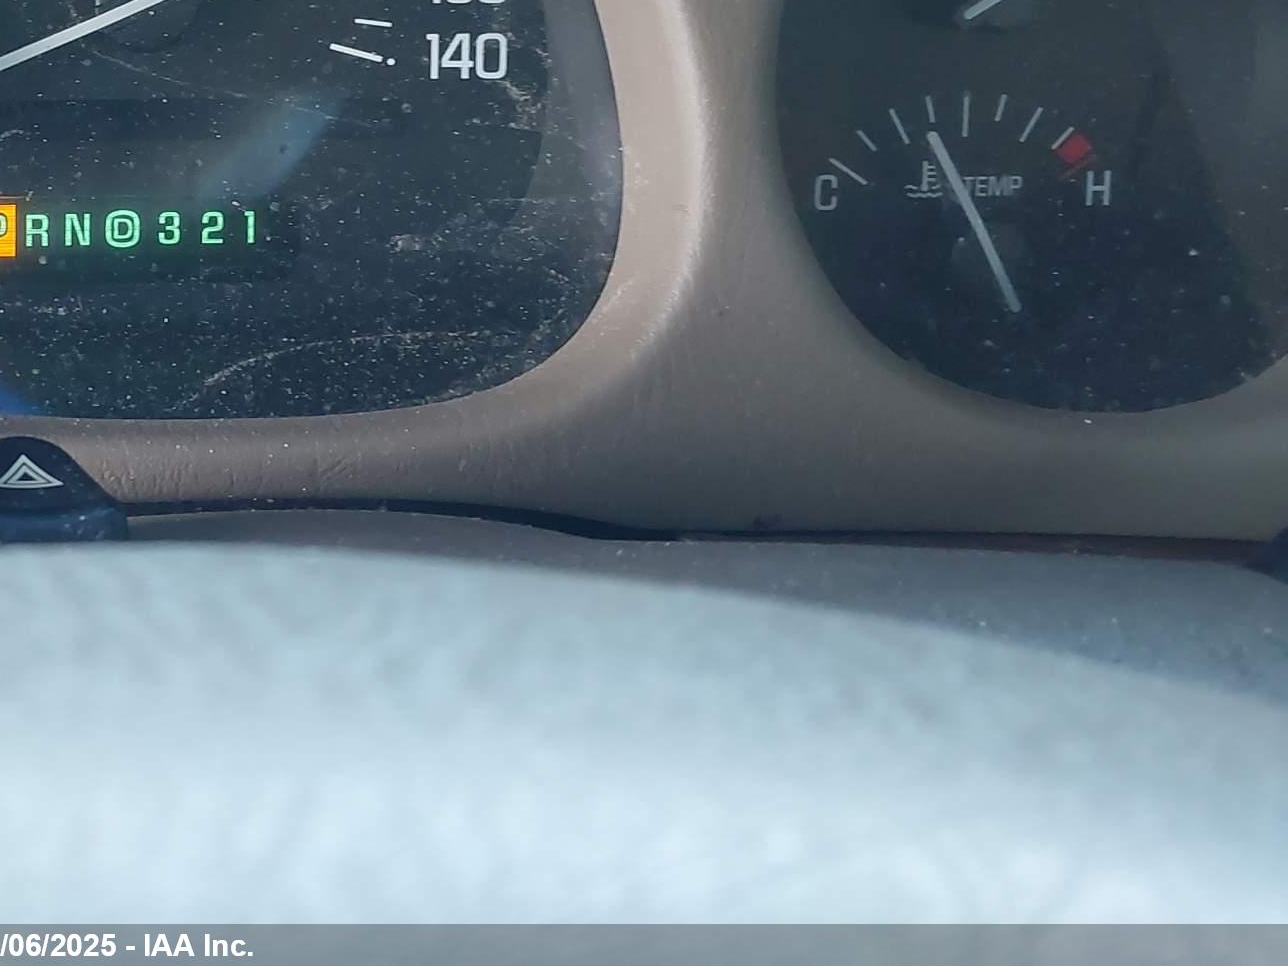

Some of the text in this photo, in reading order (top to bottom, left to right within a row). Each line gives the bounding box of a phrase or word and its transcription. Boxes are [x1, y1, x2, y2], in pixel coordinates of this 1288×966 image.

[426, 33, 507, 79] 140
[815, 175, 837, 210] C
[961, 175, 1022, 196] TEMP
[1086, 170, 1111, 205] H
[26, 215, 48, 246] R
[65, 214, 90, 245] N
[159, 212, 180, 244] 3
[202, 212, 223, 243] 2
[245, 211, 254, 243] 1
